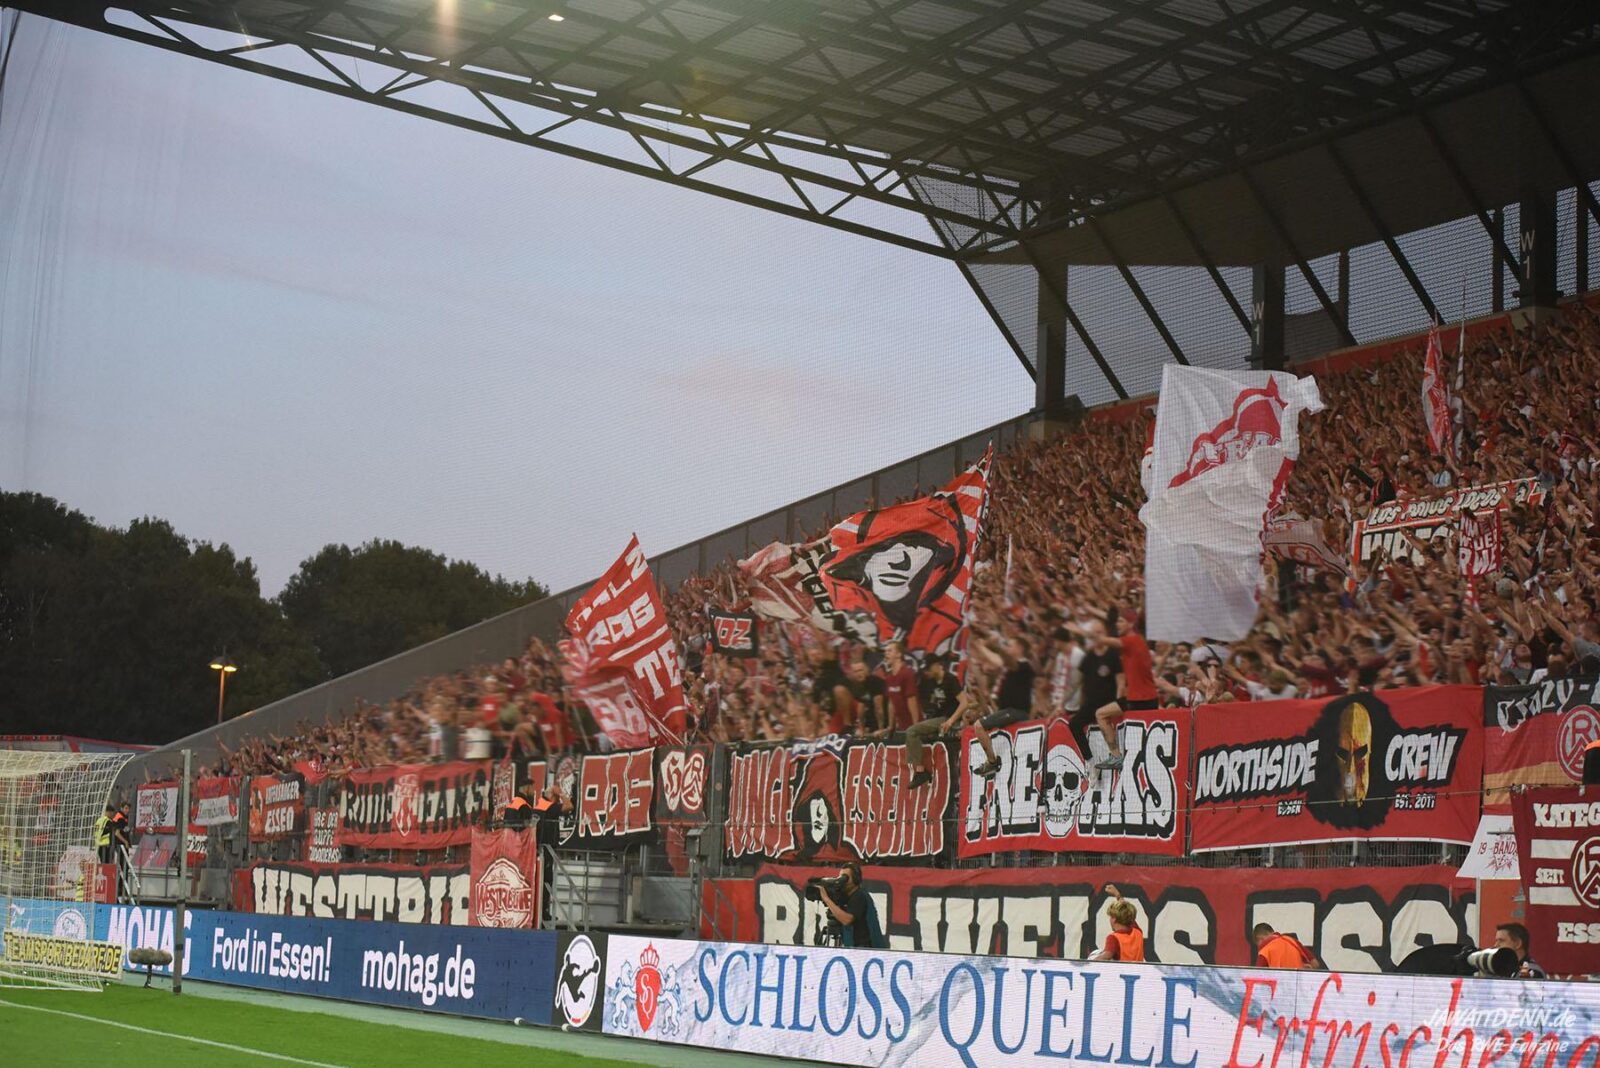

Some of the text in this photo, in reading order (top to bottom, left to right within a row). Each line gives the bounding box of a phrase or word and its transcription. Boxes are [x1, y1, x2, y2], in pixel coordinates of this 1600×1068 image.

[1497, 678, 1600, 737] Crazy-
[1195, 731, 1458, 801] NORTHSIDE CREW
[1535, 867, 1565, 885] SEIT
[212, 927, 333, 983] Ford in Essen!
[362, 940, 476, 1006] mohag.de
[694, 947, 915, 1044] SCHLOSS
[938, 960, 1200, 1068] QUELLE
